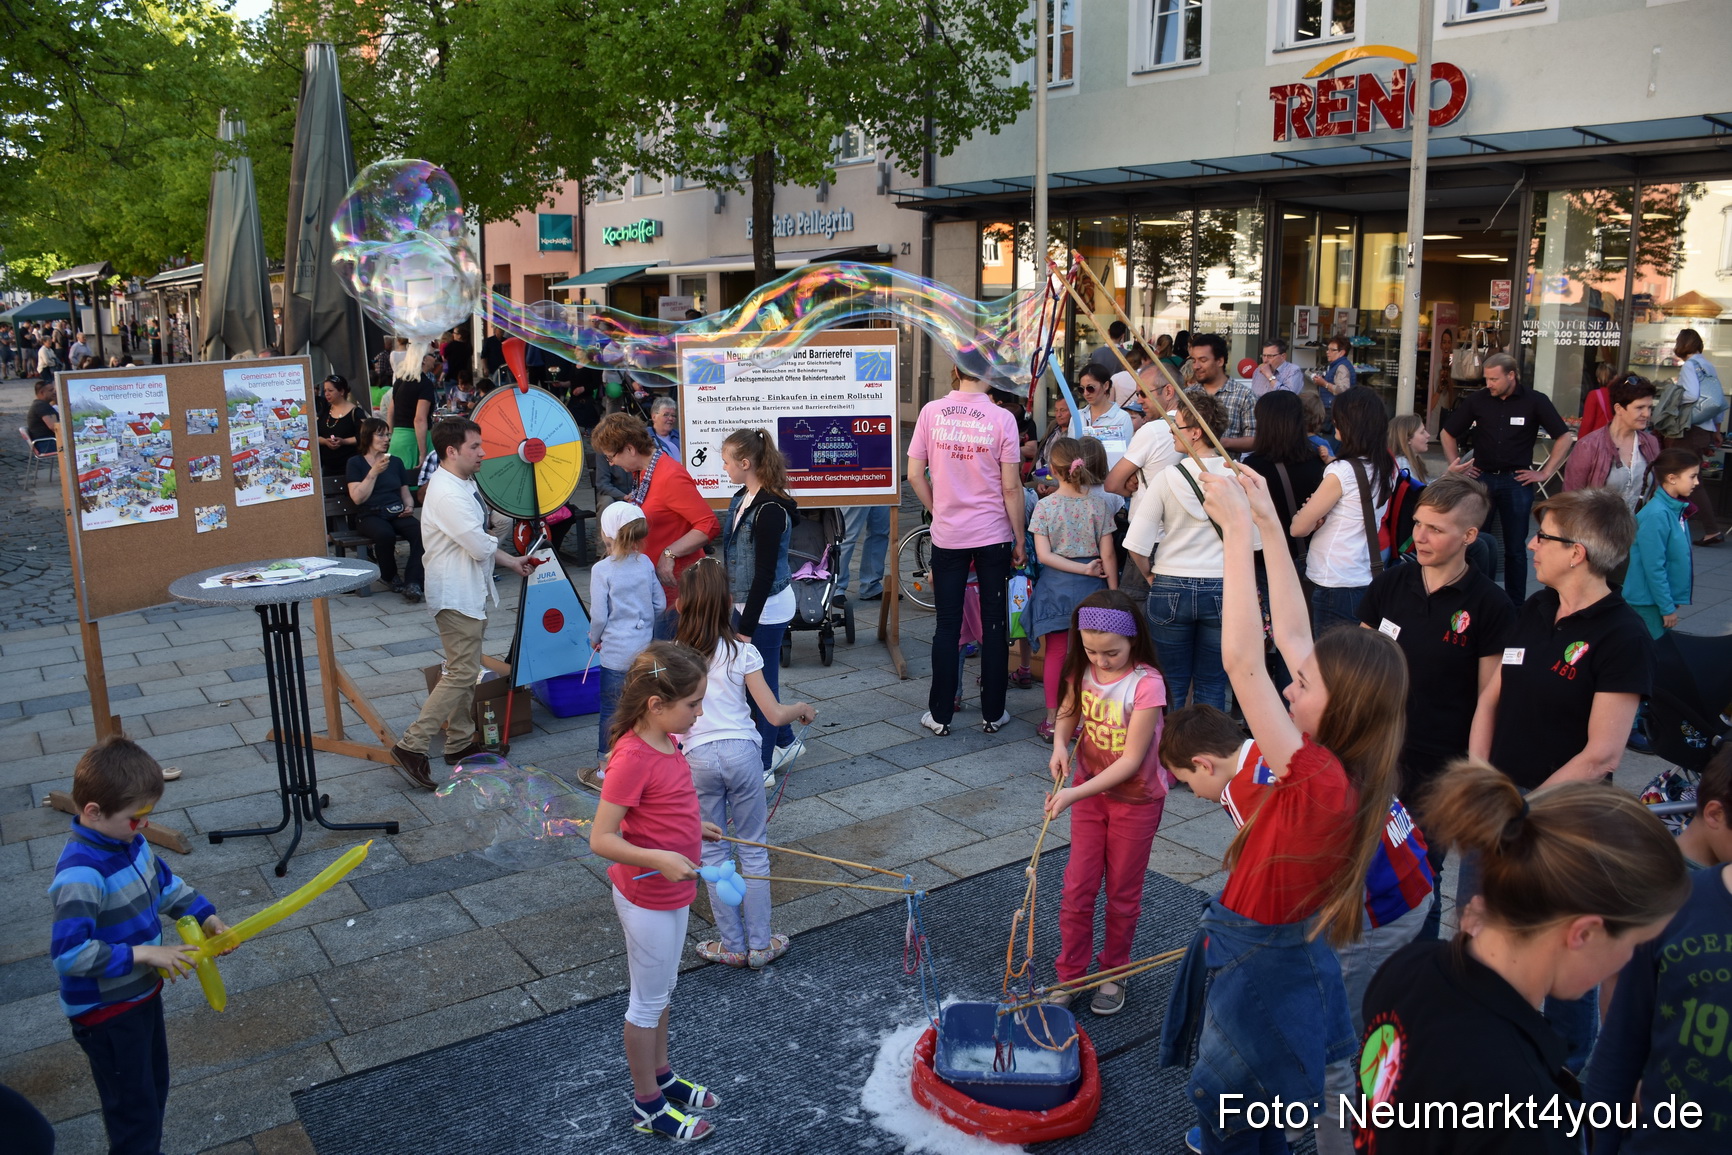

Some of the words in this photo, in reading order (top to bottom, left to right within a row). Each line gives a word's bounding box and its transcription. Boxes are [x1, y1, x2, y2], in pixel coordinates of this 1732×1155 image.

[1269, 62, 1469, 142] RENO
[796, 207, 854, 240] Pellegrin
[602, 218, 655, 246] Kochlöffel
[900, 242, 911, 254] 21
[1522, 320, 1540, 328] WIR
[1542, 321, 1564, 330] SIND
[1566, 320, 1586, 330] FÜR
[1588, 321, 1603, 330] SIE
[793, 350, 806, 359] und
[810, 349, 853, 359] Barrierefrei
[89, 383, 134, 392] Gemeinsam
[248, 380, 284, 388] barrierefreie
[99, 391, 143, 400] barrierefreie
[145, 390, 164, 398] Stadt
[941, 406, 967, 417] DEPUIS
[969, 408, 985, 420] 1897
[930, 427, 994, 445] Méditerranée
[936, 442, 951, 451] Voile
[951, 452, 974, 460] Régate
[825, 474, 886, 482] Geschenkgutschein
[537, 571, 556, 580] JURA
[1442, 630, 1467, 647] ABD
[1550, 660, 1577, 680] ABD
[1082, 690, 1123, 726] SUN
[1386, 807, 1415, 848] MÜLLE
[1659, 934, 1732, 973] CCE
[1678, 997, 1732, 1063] 19
